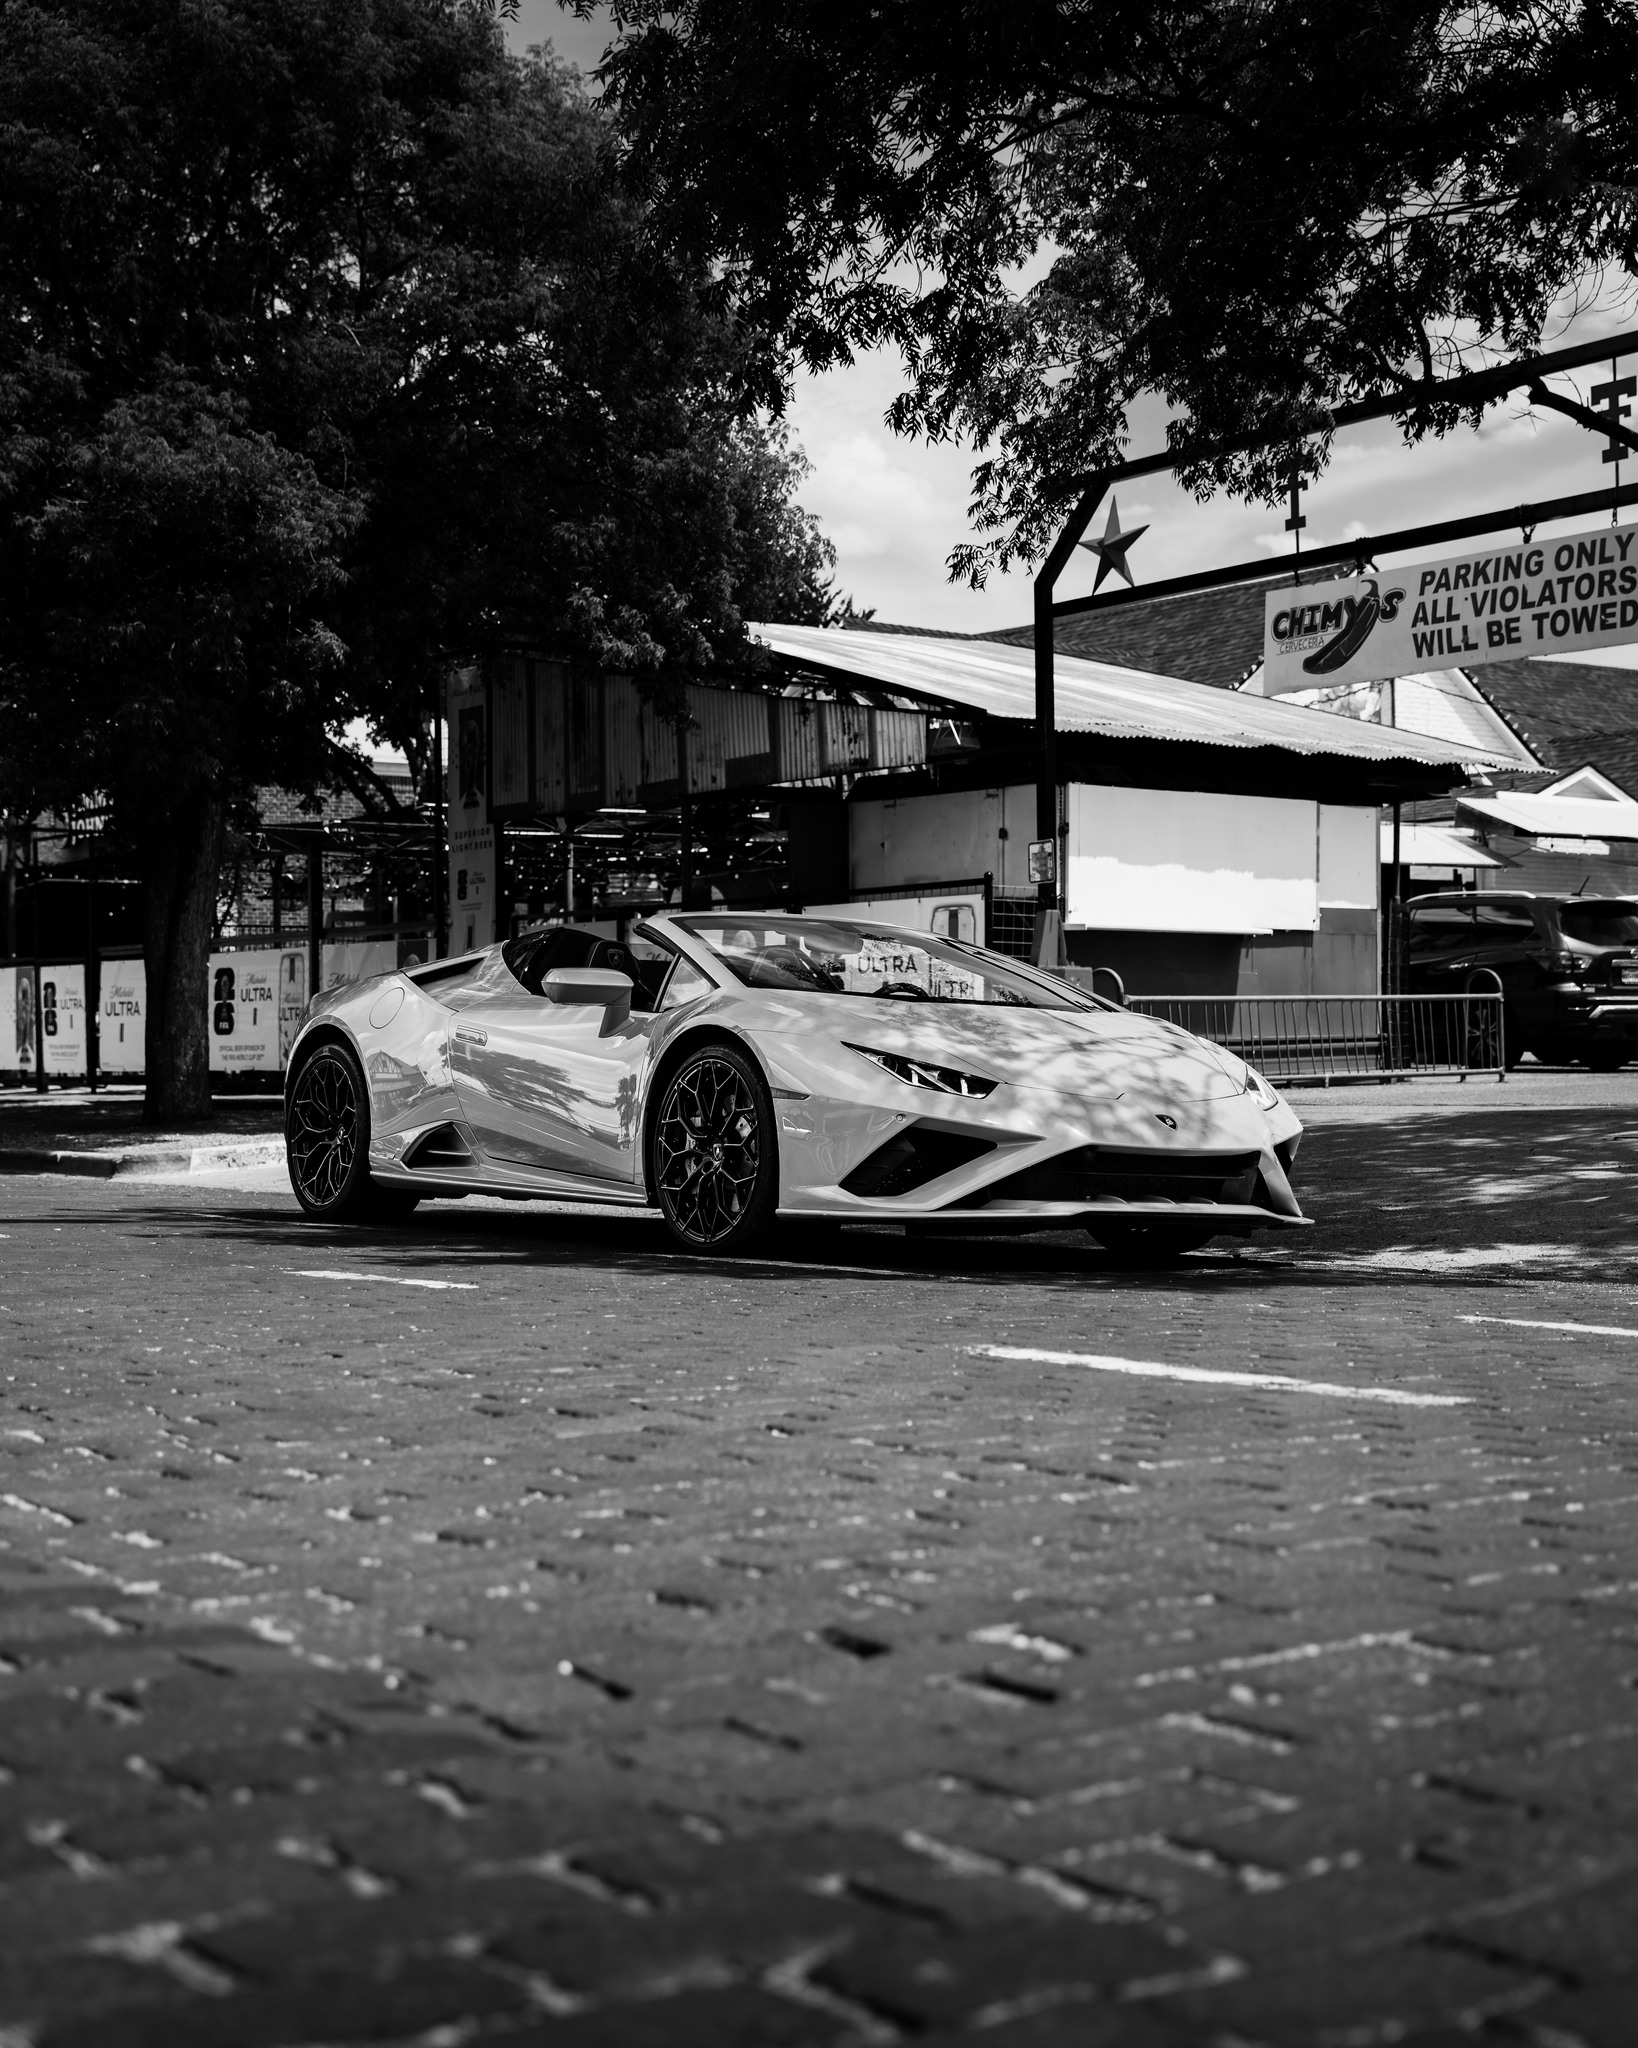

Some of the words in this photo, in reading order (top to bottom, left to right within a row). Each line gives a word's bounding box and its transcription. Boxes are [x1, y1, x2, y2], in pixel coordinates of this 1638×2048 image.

[1419, 549, 1544, 597] PARKING
[1554, 532, 1636, 572] ONLY
[1411, 596, 1460, 628] ALL
[1470, 565, 1638, 618] VIOLATORS
[1412, 625, 1478, 658] WILL
[1486, 616, 1521, 648] BE
[1531, 599, 1638, 640] TOWED
[1279, 636, 1325, 654] CERVECERIA
[454, 827, 490, 840] SUPERIOR
[452, 842, 473, 853] LIGHT
[474, 839, 493, 850] BEER
[857, 954, 918, 974] ULTRA
[240, 987, 273, 1003] ULTRA
[60, 998, 84, 1010] ULTRA
[105, 1000, 141, 1017] ULTRA
